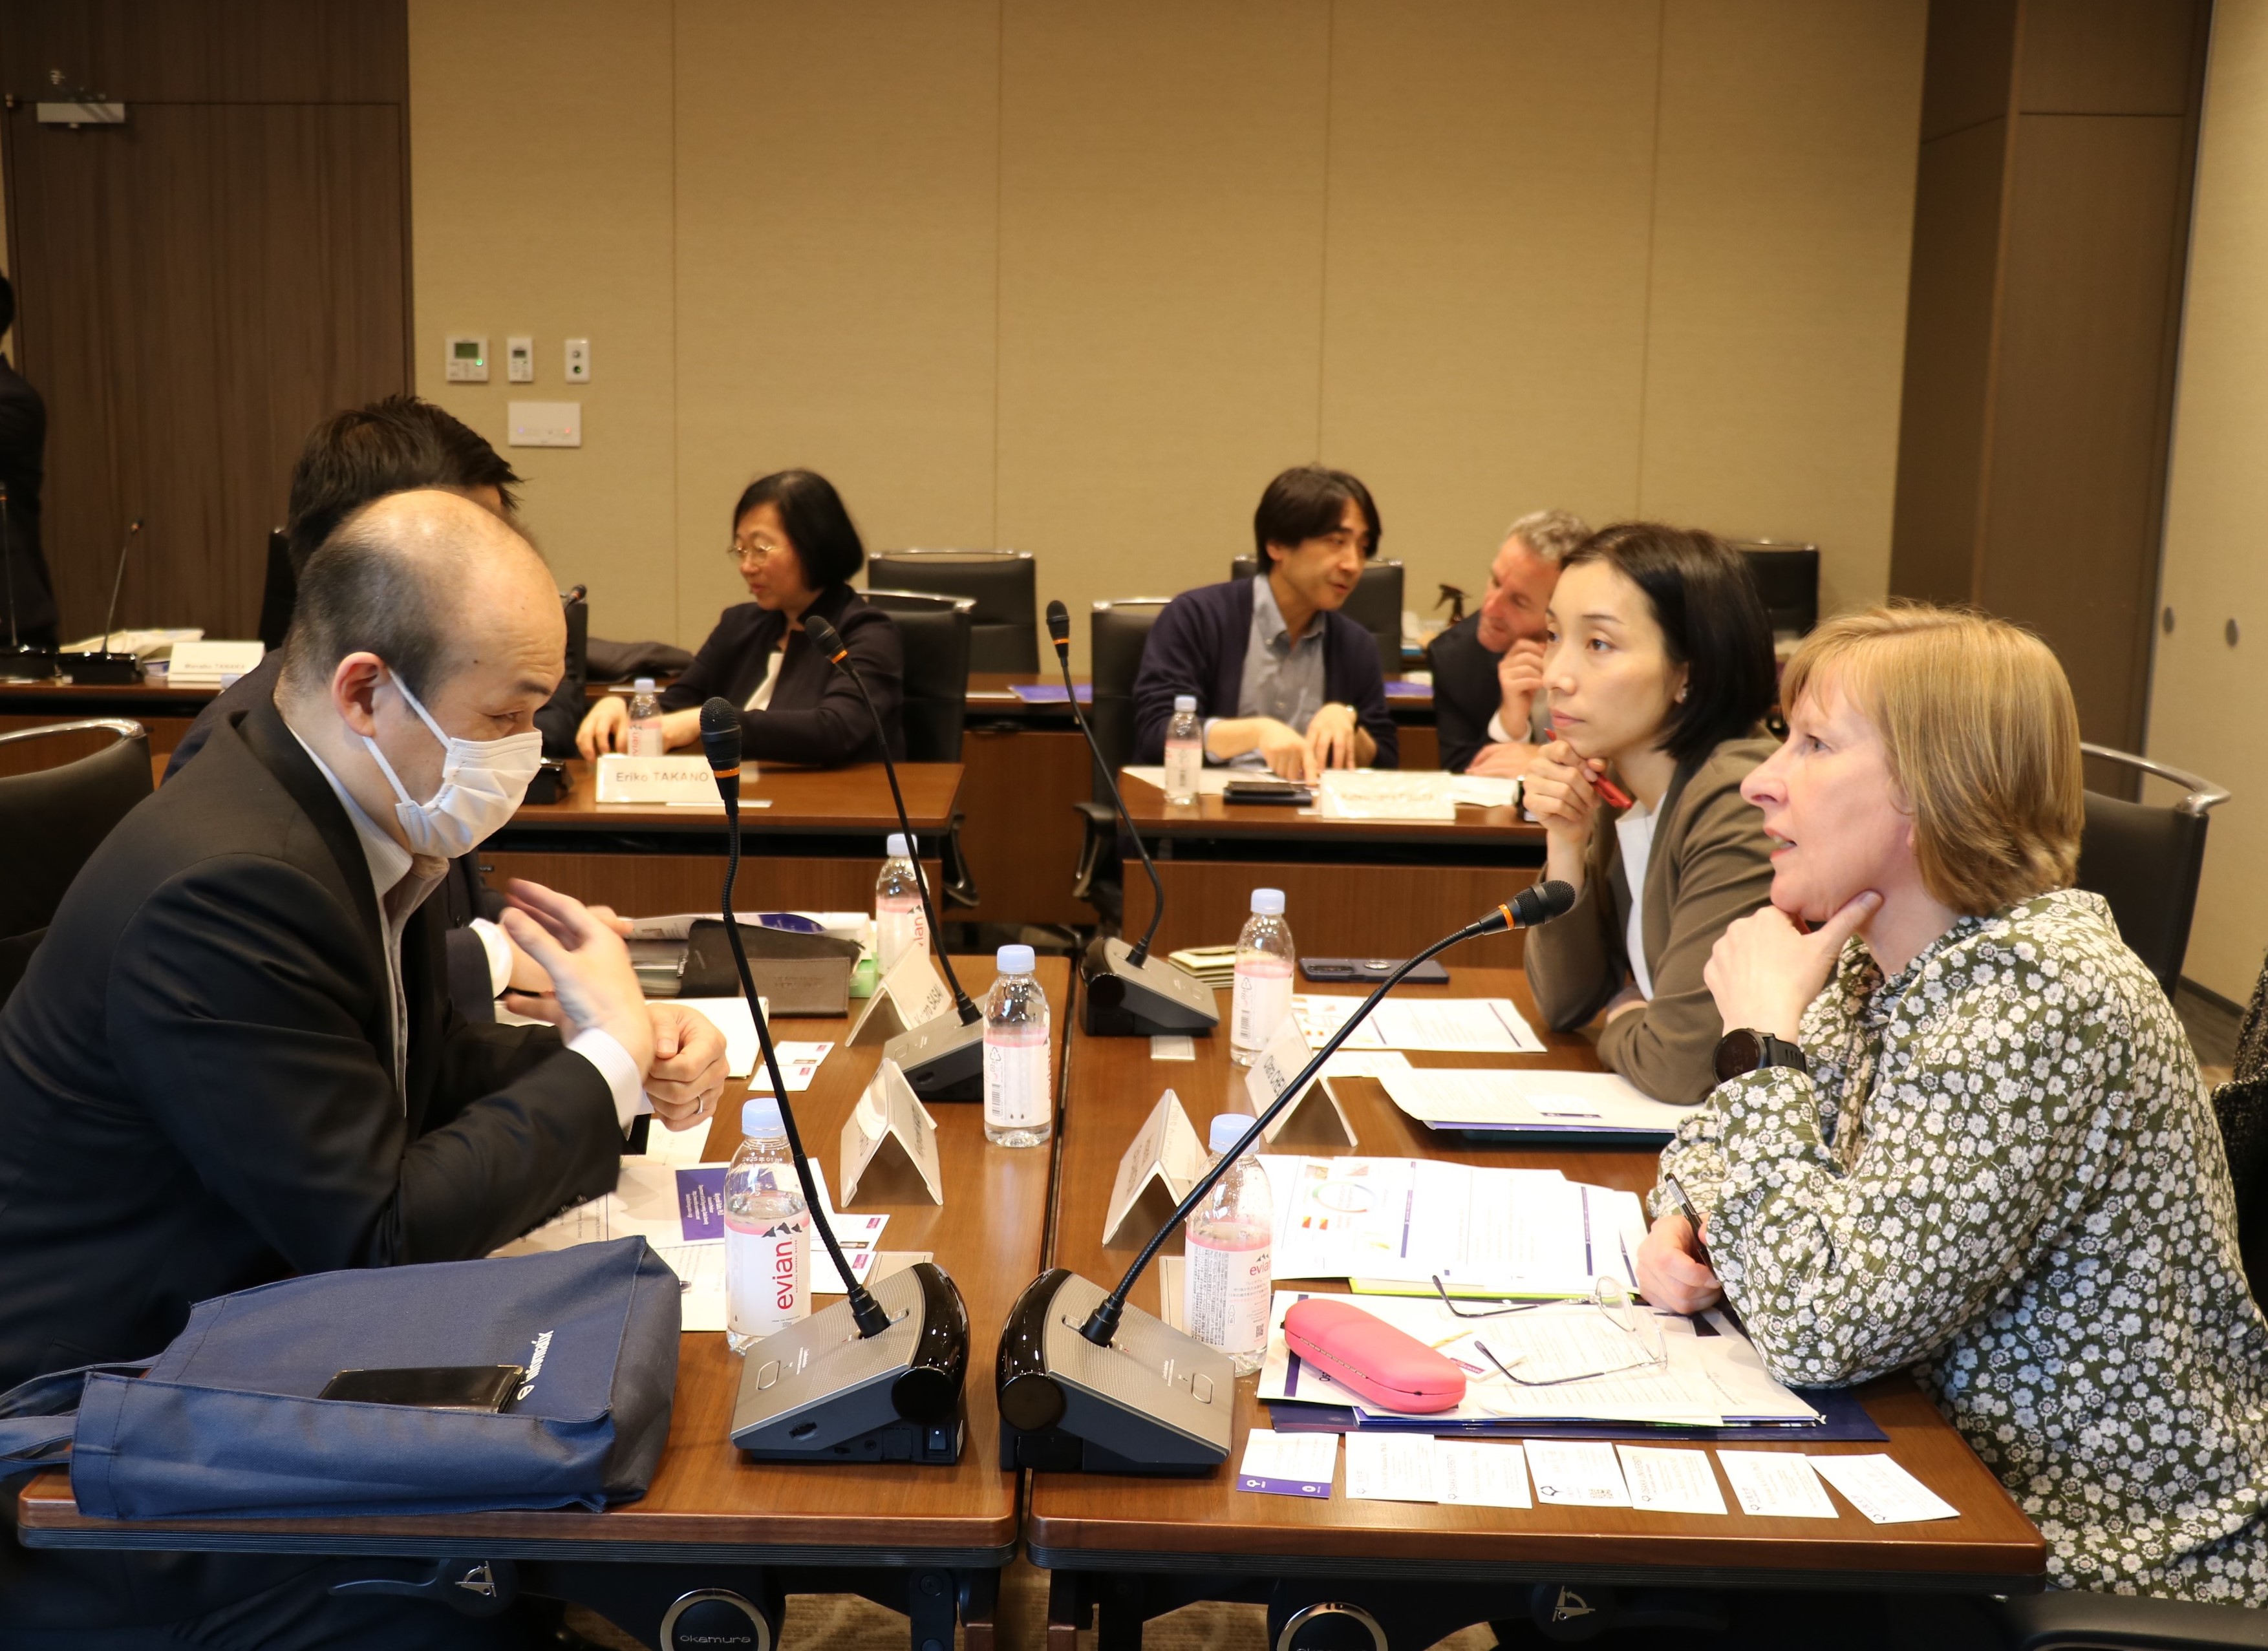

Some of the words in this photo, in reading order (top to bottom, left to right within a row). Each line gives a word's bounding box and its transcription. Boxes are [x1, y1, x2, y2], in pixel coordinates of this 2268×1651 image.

[616, 772, 648, 782] Eriko
[654, 771, 709, 782] TAKANO
[927, 983, 944, 1011] SASAI
[1270, 1070, 1288, 1097] CHEU
[772, 1241, 794, 1310] evian
[520, 1330, 554, 1385] informatix
[679, 1635, 751, 1644] okamura
